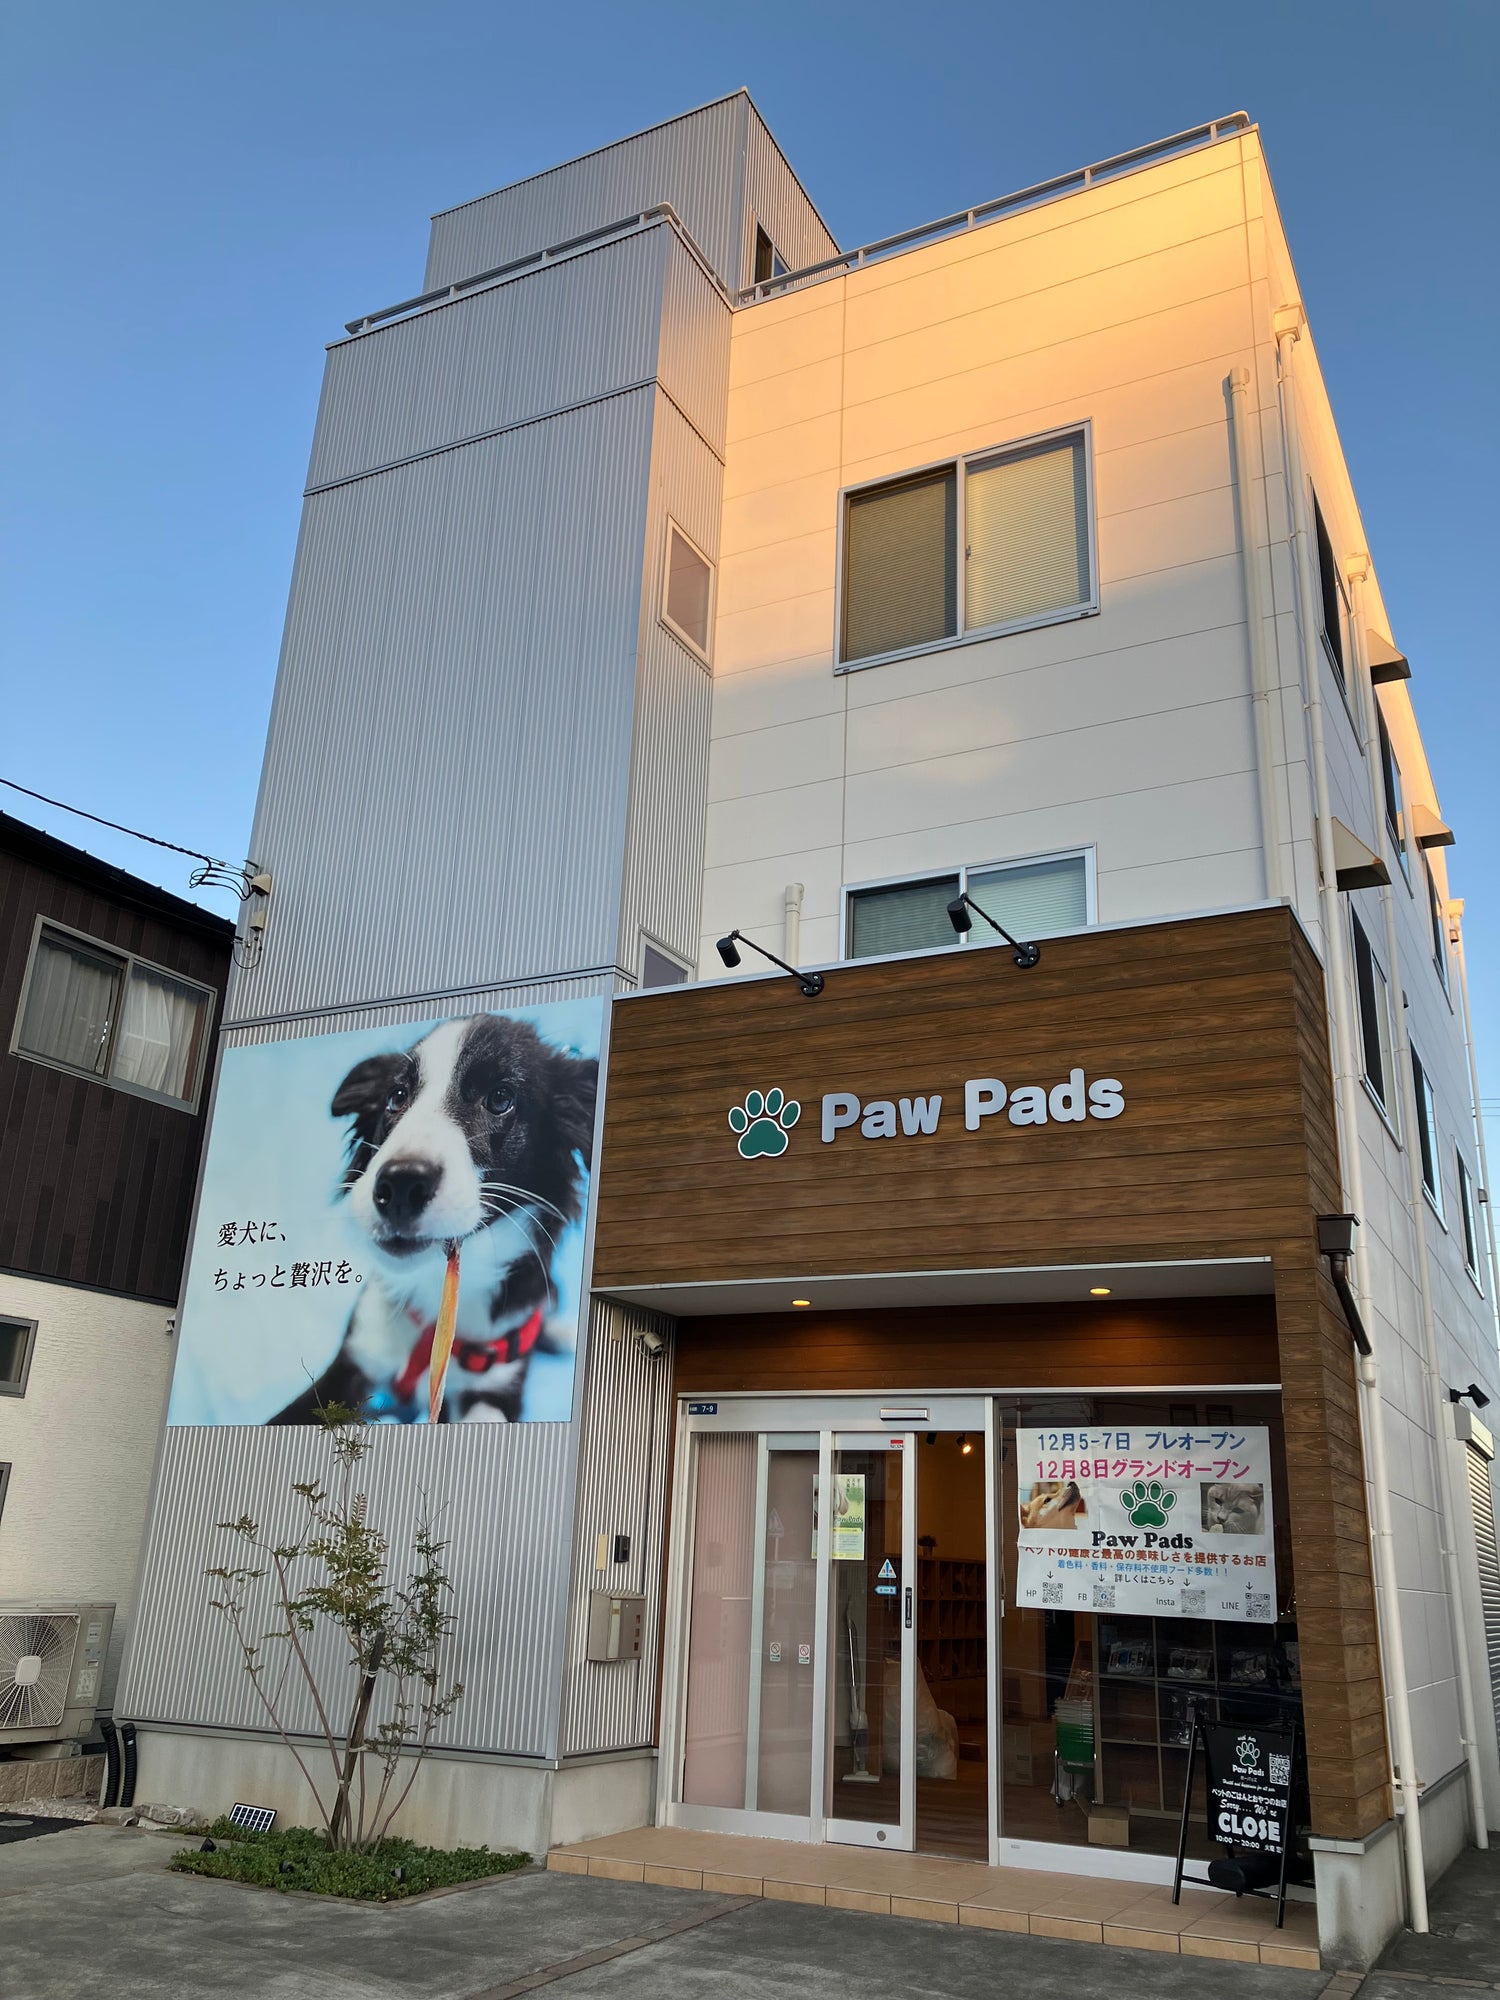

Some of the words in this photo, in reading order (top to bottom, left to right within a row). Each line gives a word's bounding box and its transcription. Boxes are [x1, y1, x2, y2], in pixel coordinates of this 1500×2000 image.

[821, 1092, 943, 1143] Paw
[964, 1068, 1126, 1131] Pads
[217, 1220, 286, 1247] 愛犬に、
[214, 1260, 363, 1291] ちょっと贅沢を。
[1037, 1432, 1130, 1451] 12月5-7日
[1145, 1431, 1246, 1451] プレオープン
[1036, 1459, 1250, 1479] 12月8日グランドオープン
[1091, 1531, 1138, 1547] Paw
[1144, 1532, 1193, 1549] Pads
[1115, 1574, 1175, 1586] 詳しくはこちら
[1078, 1593, 1088, 1601] FB
[1156, 1598, 1175, 1606] Insta
[1221, 1601, 1240, 1610] LINE
[1232, 1764, 1247, 1774] Paw
[1248, 1767, 1265, 1777] Pads
[1218, 1812, 1281, 1842] CLOSE
[1215, 1834, 1233, 1844] 10:00
[1241, 1839, 1260, 1849] 20:00
